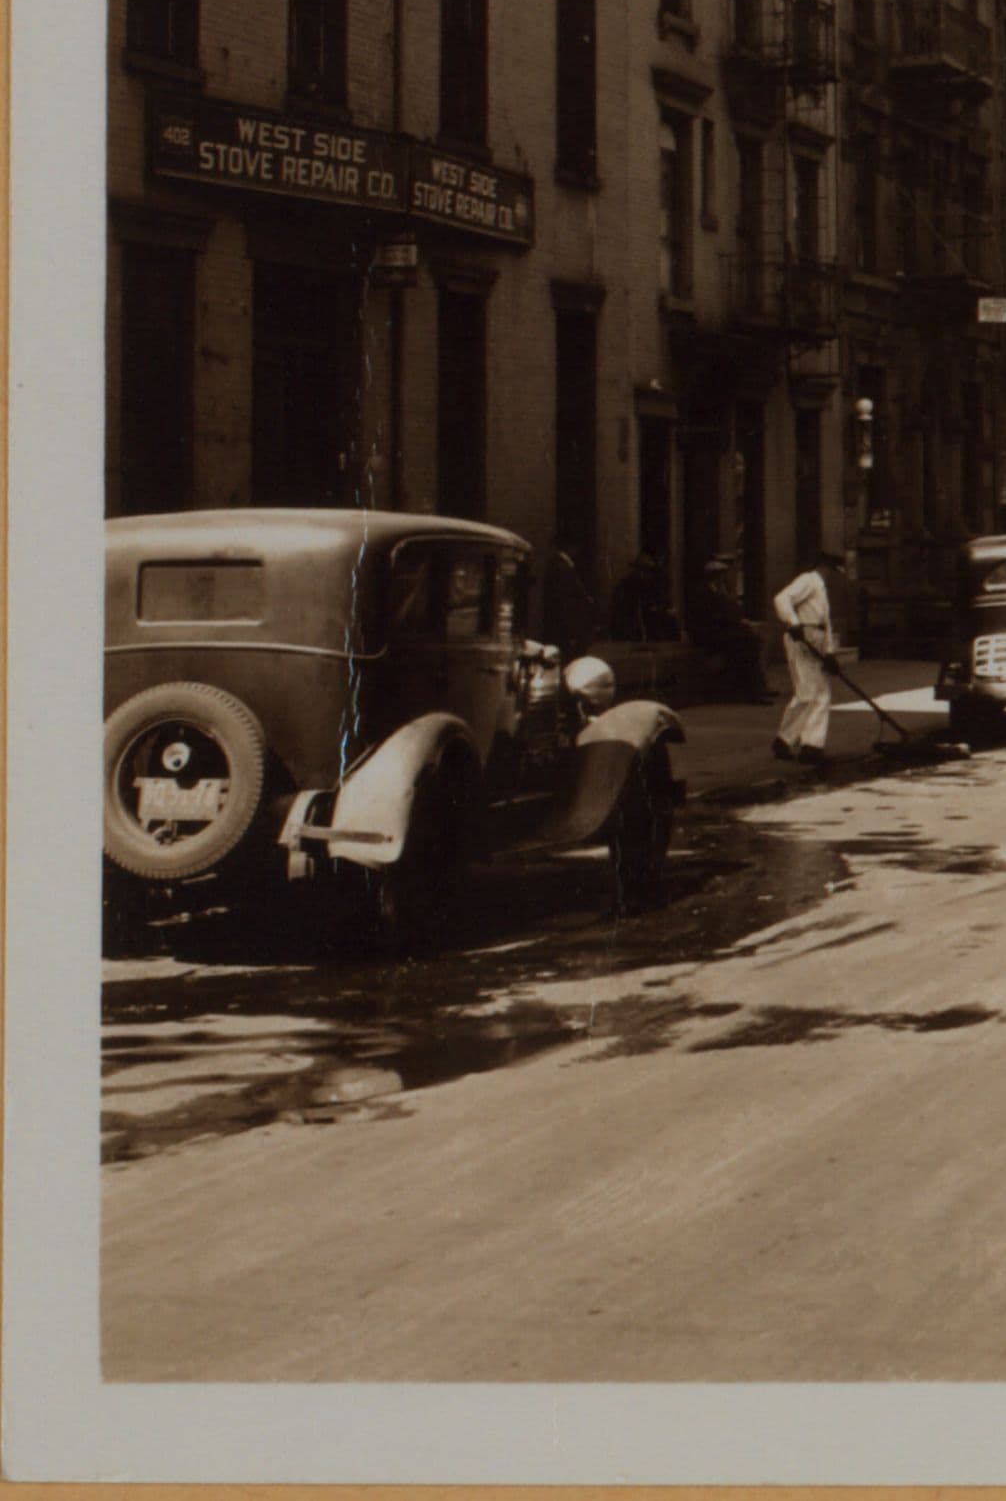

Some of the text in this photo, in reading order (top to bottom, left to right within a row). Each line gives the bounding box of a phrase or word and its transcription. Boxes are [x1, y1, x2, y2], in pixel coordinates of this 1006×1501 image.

[163, 125, 192, 147] 402
[237, 117, 367, 164] WEST SIDE
[198, 141, 273, 180] STOVE
[281, 156, 359, 196] REPAIR
[431, 158, 498, 199] WEST SIDE
[413, 180, 454, 215] STOVE
[455, 191, 497, 227] REPAIR
